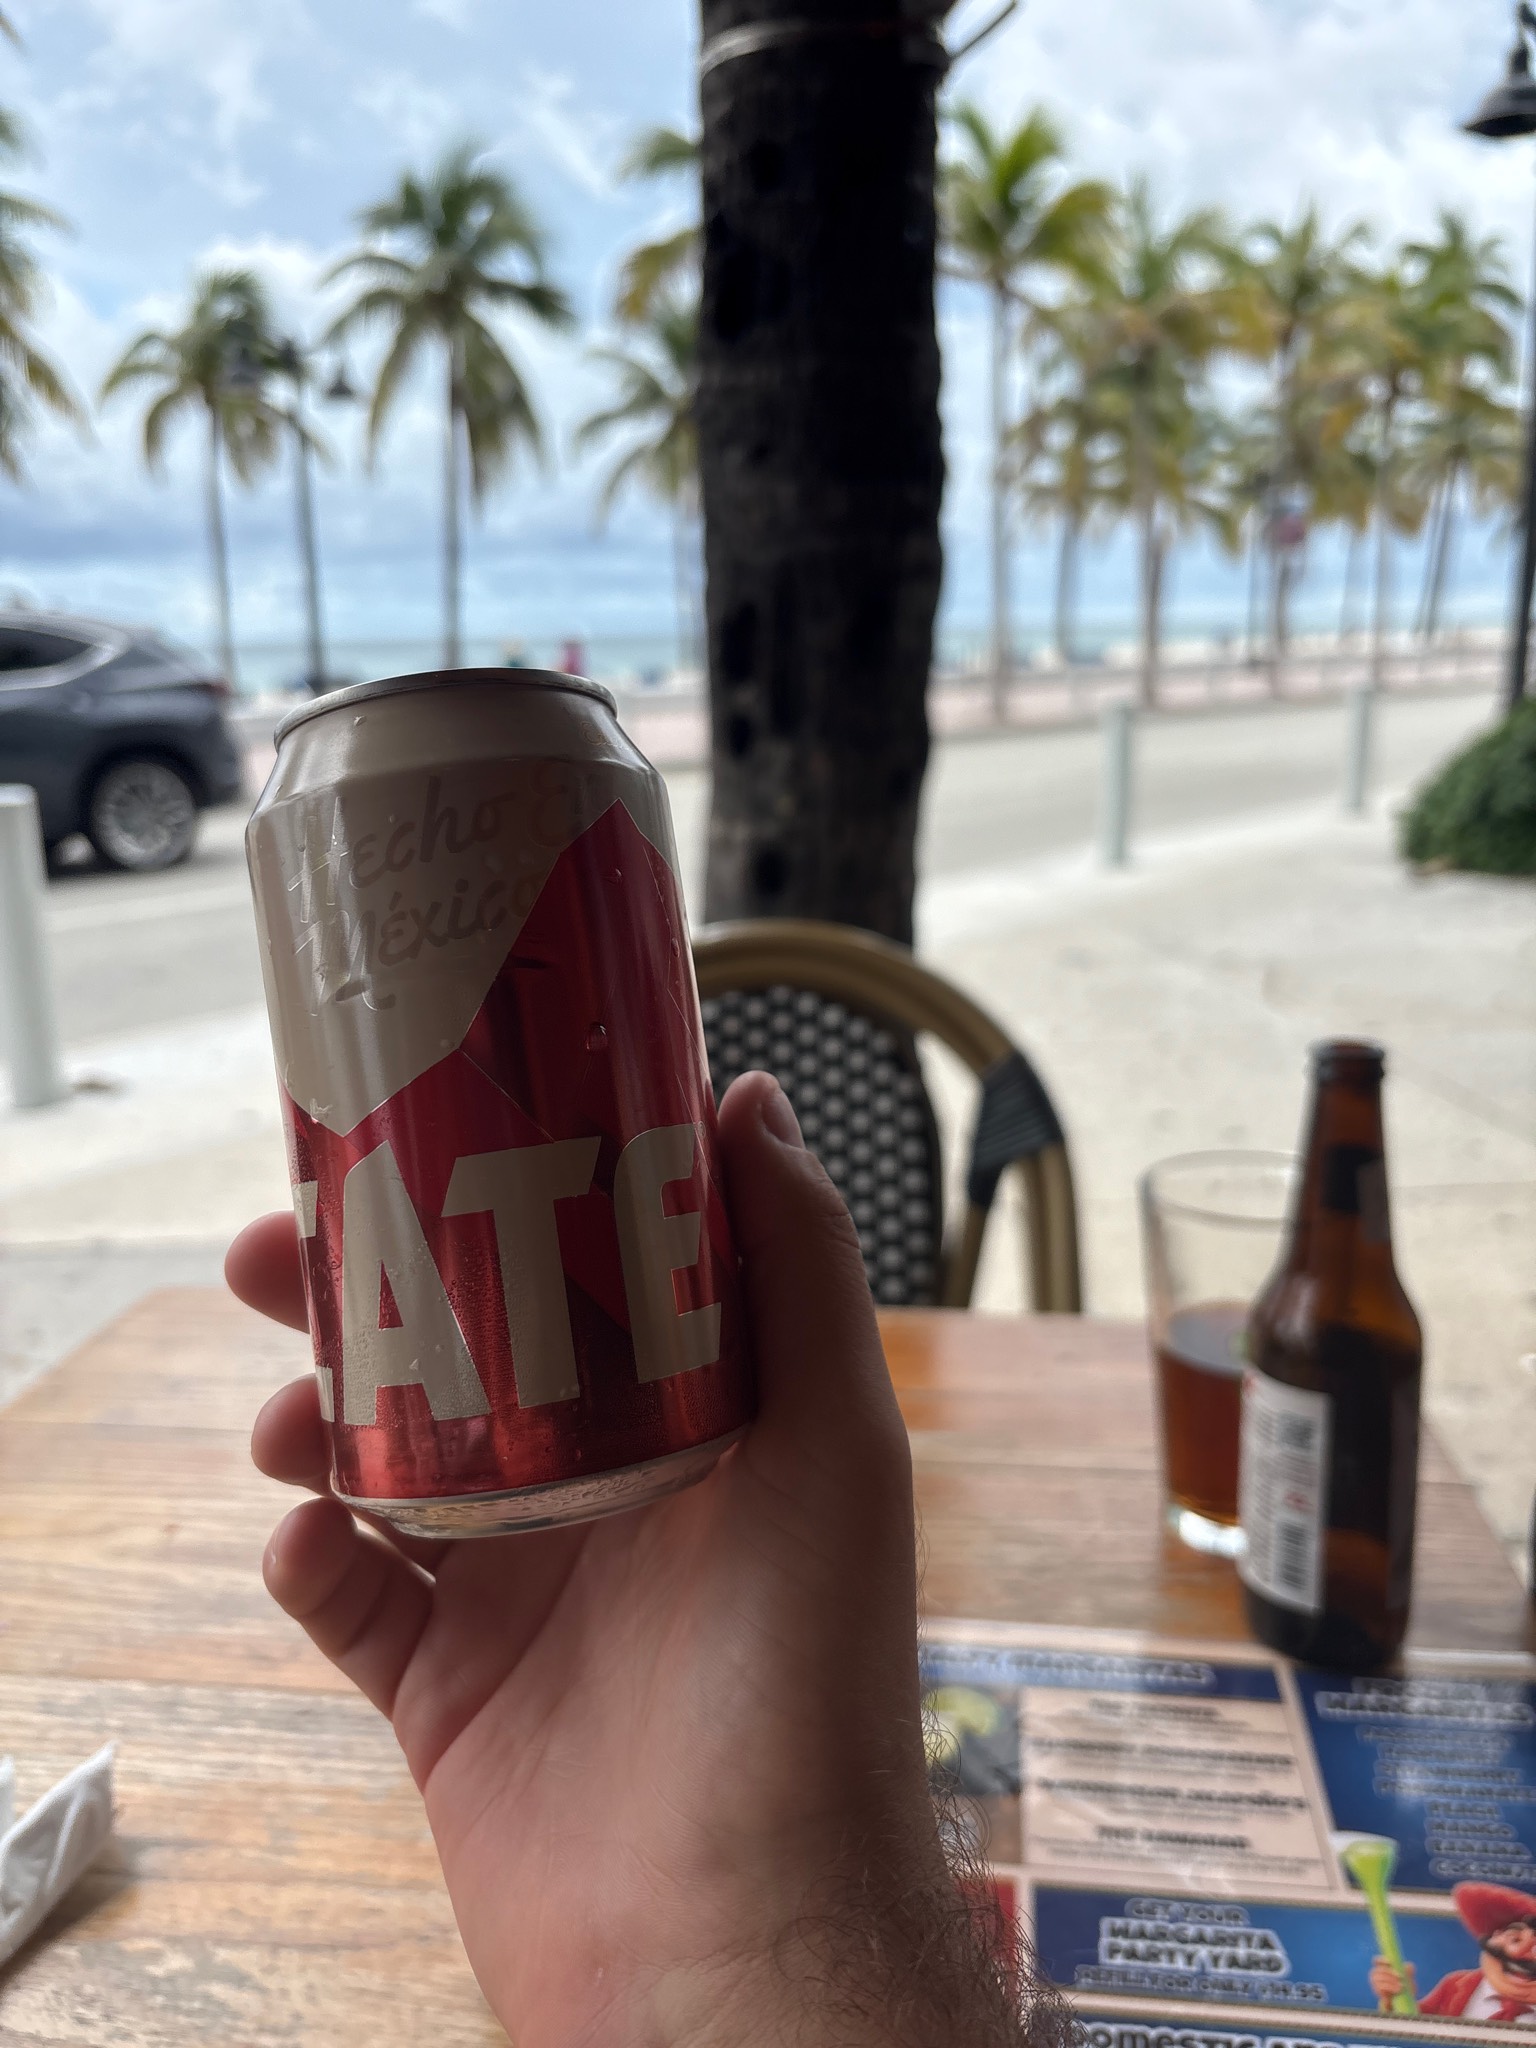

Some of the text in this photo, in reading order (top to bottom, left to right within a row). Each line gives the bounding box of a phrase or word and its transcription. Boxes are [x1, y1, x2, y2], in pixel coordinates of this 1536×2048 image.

[293, 1122, 722, 1426] ATE
[1108, 1920, 1275, 1949] MARGARITA
[1107, 1941, 1284, 1973] PARTY YARD
